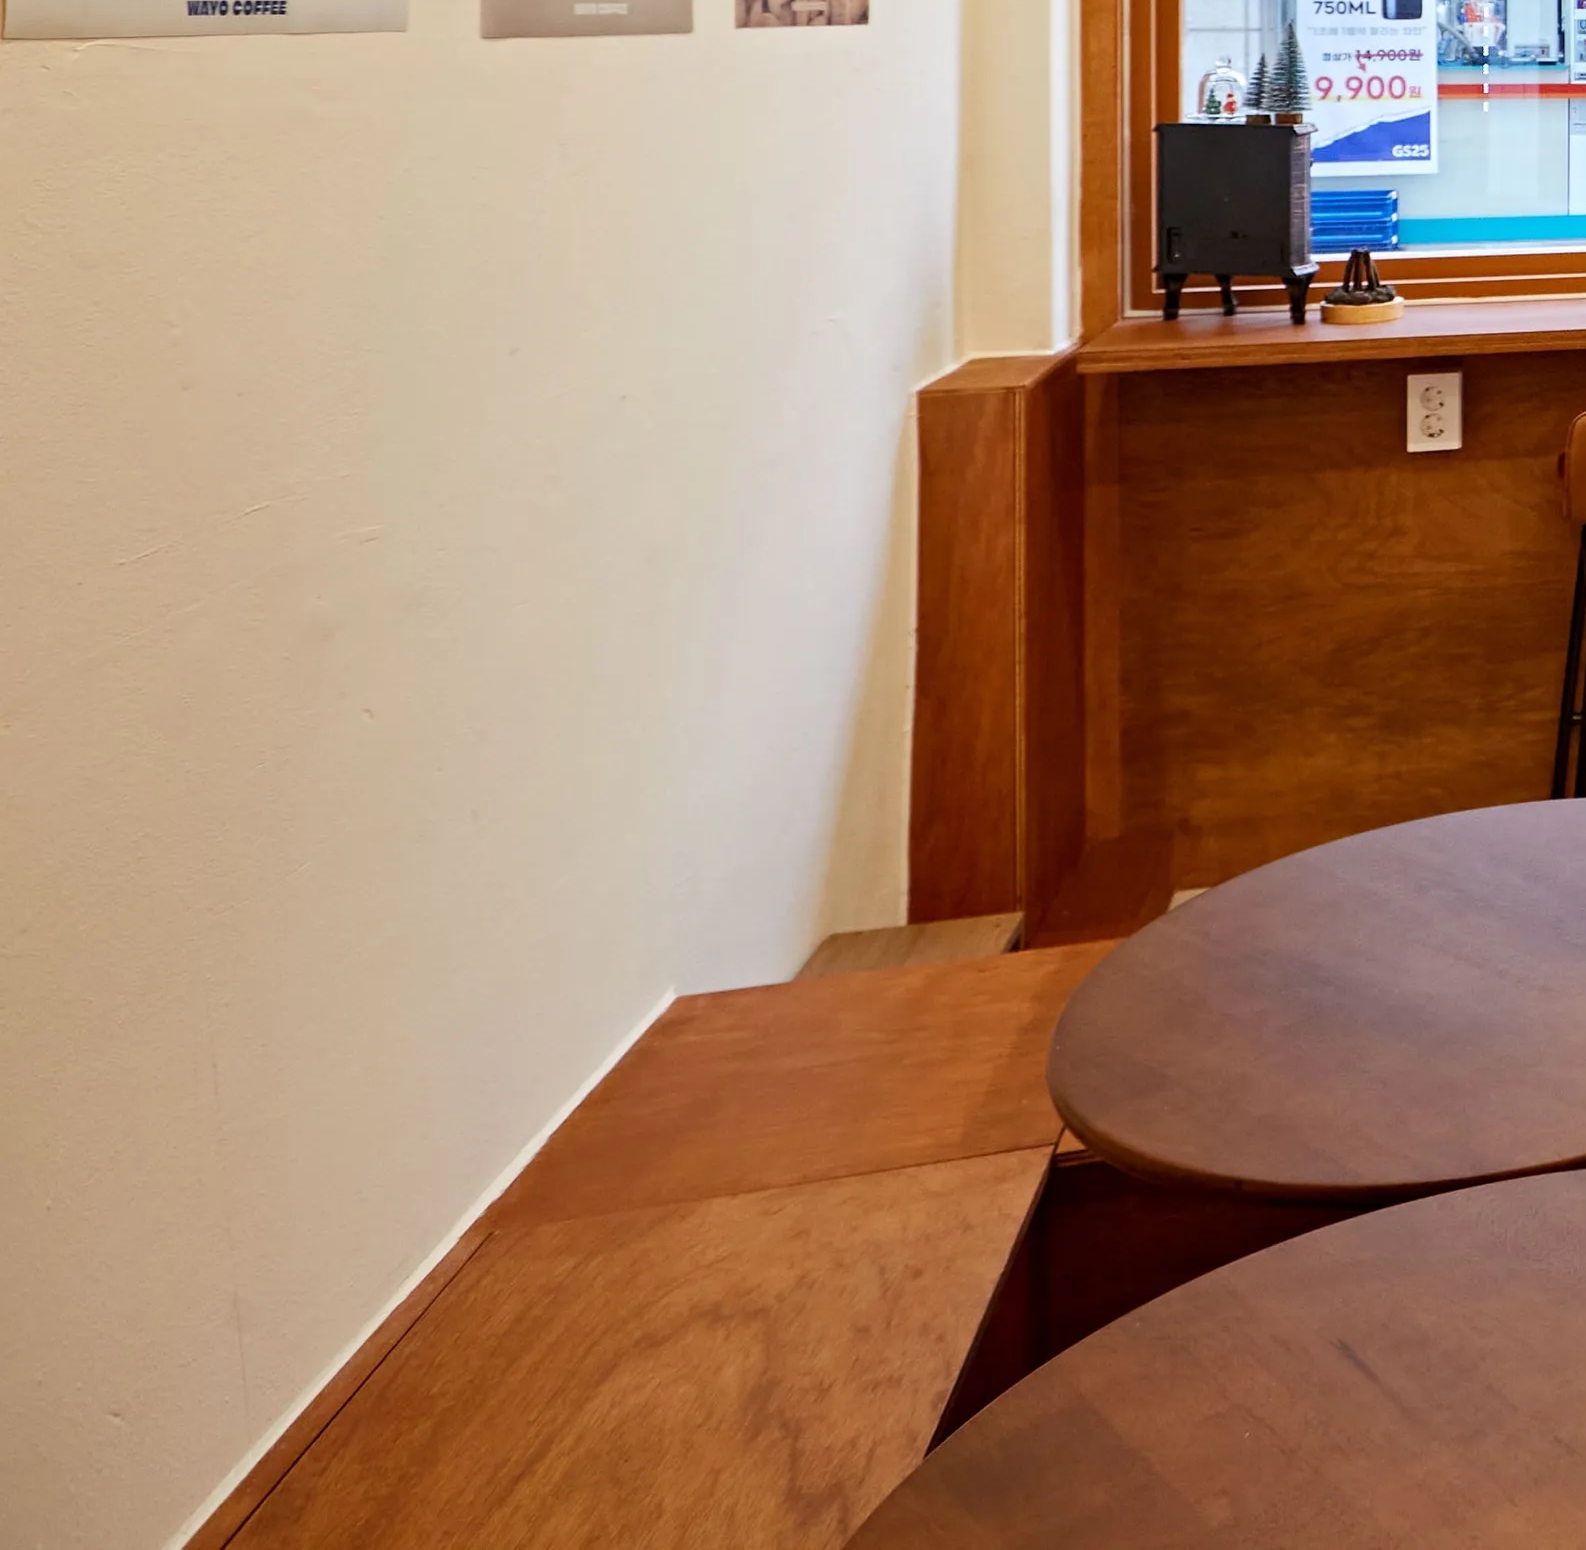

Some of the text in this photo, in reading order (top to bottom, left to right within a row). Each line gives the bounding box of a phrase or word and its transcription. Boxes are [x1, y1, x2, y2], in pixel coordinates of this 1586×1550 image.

[187, 0, 287, 16] WAYO COFFEE
[1313, 0, 1376, 15] 750ML
[1391, 144, 1429, 158] GS25
